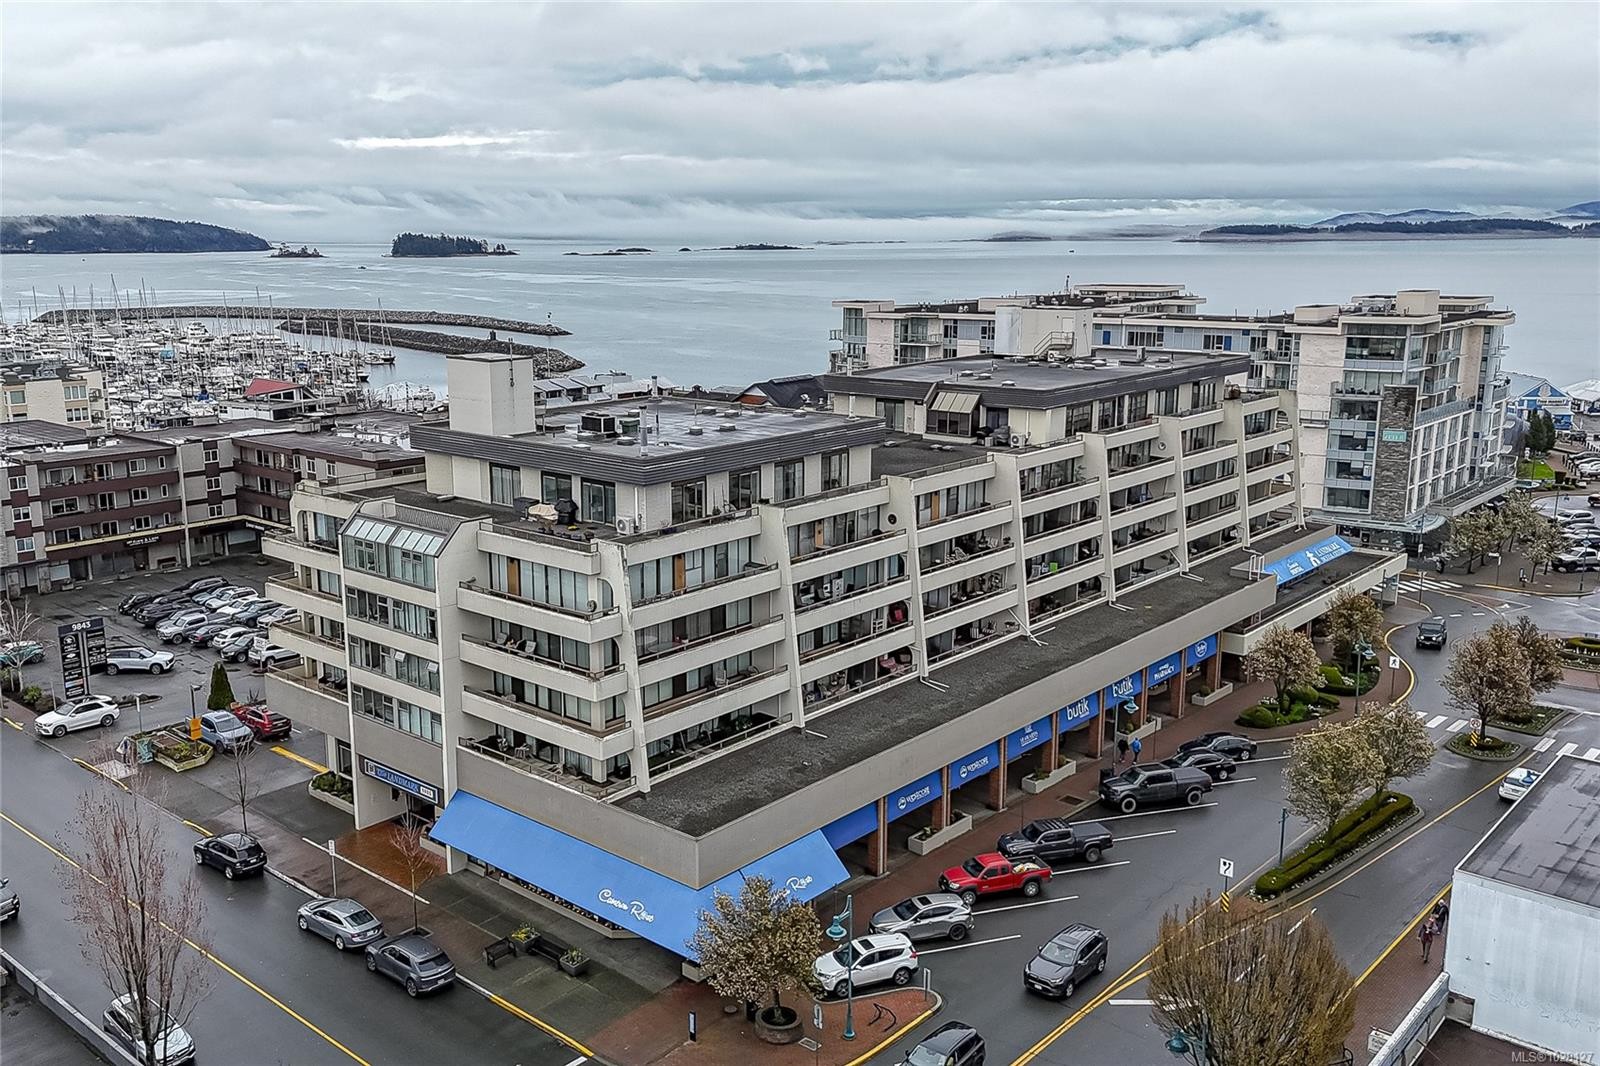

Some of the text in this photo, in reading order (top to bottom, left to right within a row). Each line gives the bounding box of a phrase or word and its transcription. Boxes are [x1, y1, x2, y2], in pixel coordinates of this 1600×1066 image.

[71, 620, 91, 632] 9843
[1112, 676, 1133, 697] butik
[1066, 697, 1089, 721] butik
